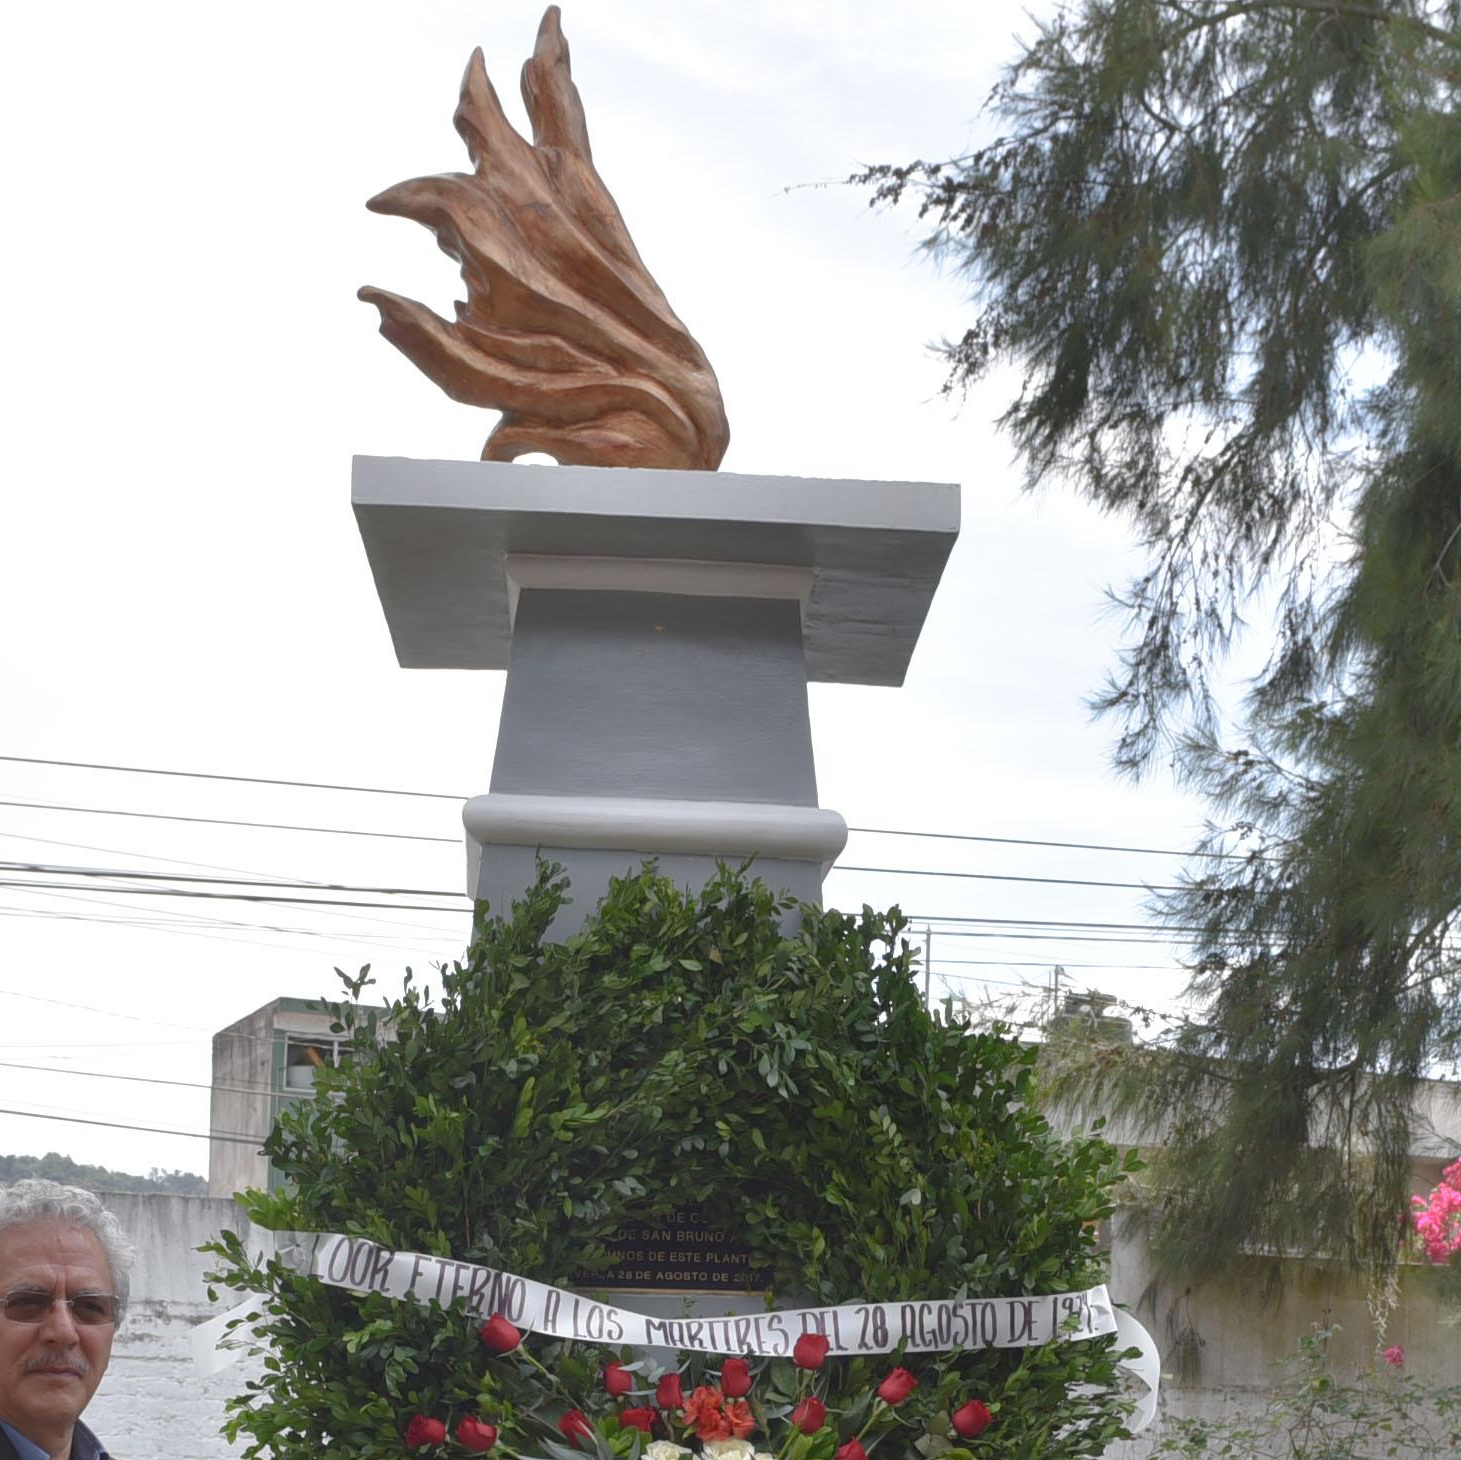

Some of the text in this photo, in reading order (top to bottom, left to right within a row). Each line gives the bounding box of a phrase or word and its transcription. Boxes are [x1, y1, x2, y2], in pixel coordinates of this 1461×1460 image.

[641, 1230, 671, 1241] SAN
[676, 1231, 725, 1242] BRUNO
[648, 1251, 666, 1262] DE
[669, 1252, 701, 1263] ESTE
[706, 1253, 751, 1264] PLANT
[635, 1271, 653, 1280] DE
[655, 1271, 708, 1281] AGOSTO
[712, 1272, 729, 1282] DE
[306, 1234, 391, 1293] LOOR
[406, 1255, 527, 1322] ETERNO
[543, 1289, 561, 1334] A
[572, 1298, 624, 1341] LOS
[644, 1314, 790, 1356] MARTIRES
[854, 1305, 889, 1351] 28
[900, 1302, 998, 1350] AGOSTO
[1006, 1300, 1040, 1344] DE
